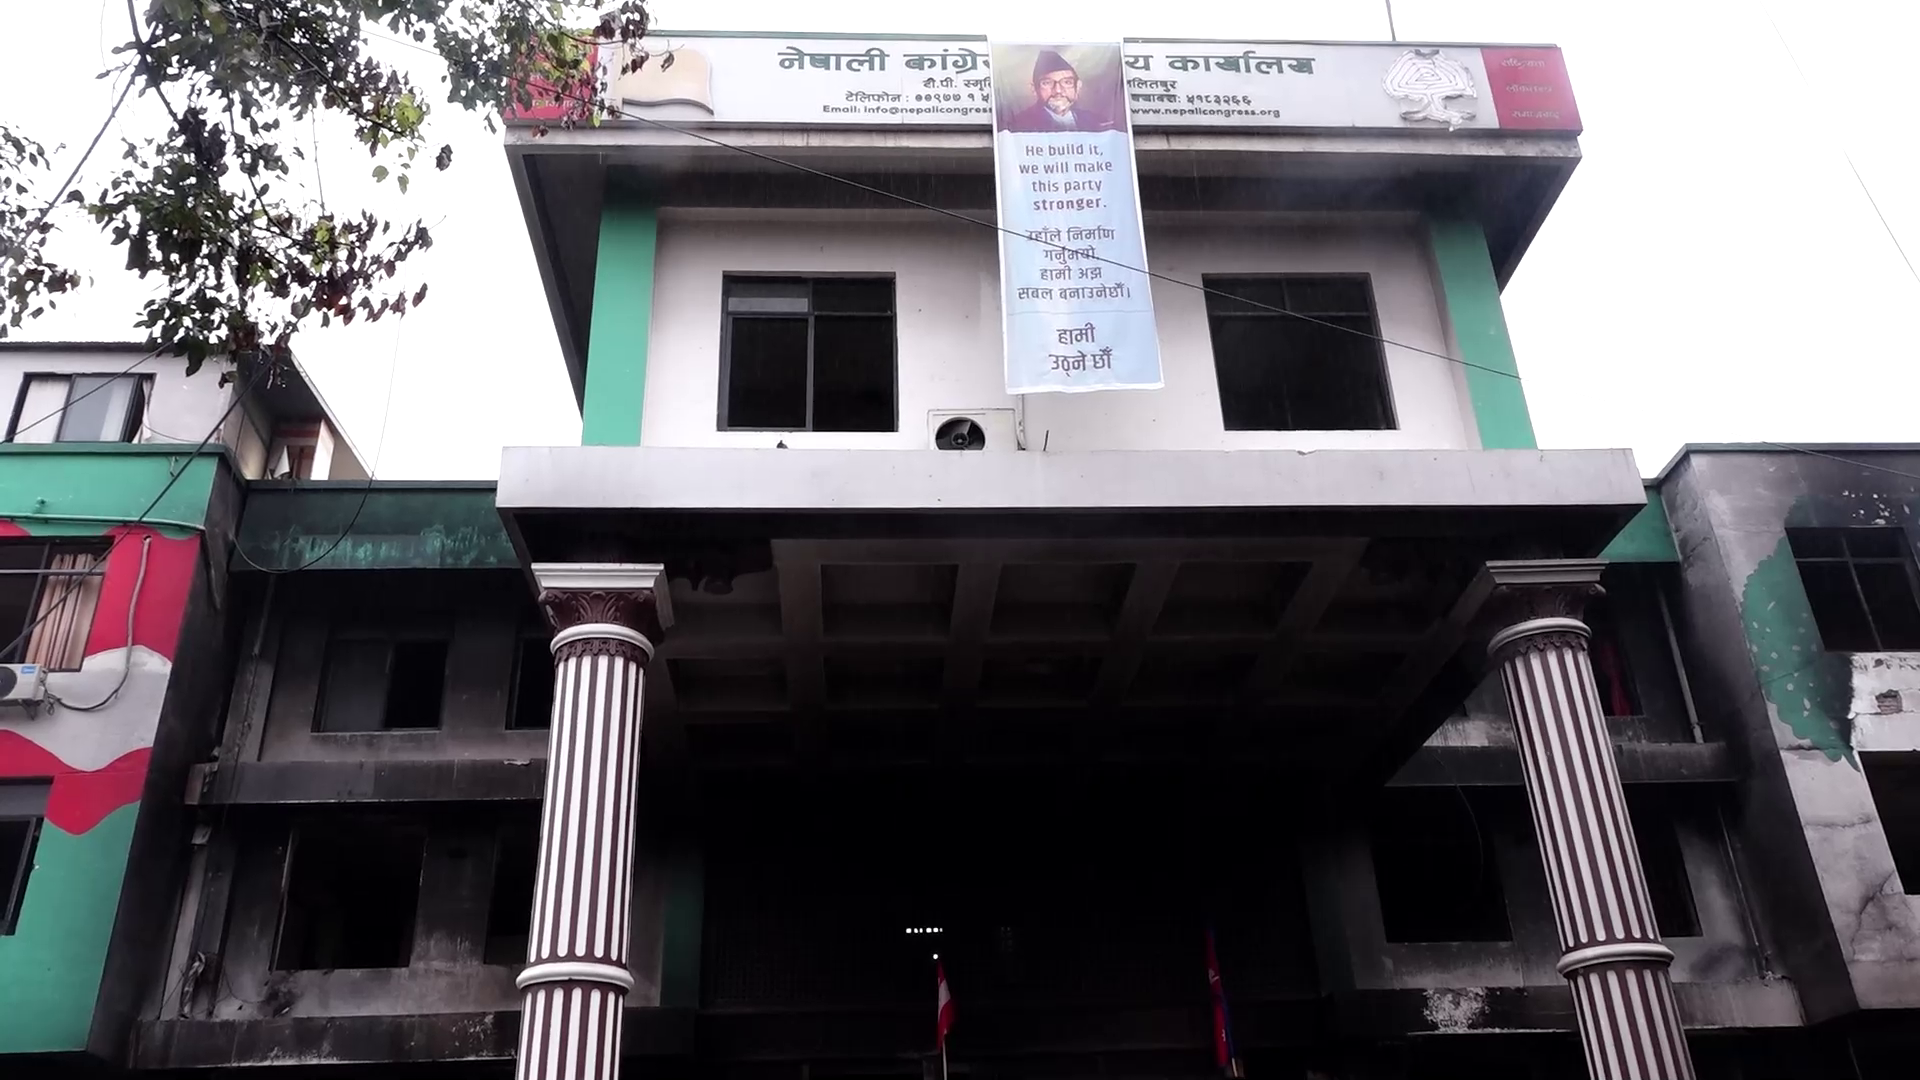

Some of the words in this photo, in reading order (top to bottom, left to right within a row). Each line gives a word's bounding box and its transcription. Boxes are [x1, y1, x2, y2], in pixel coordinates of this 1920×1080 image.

[903, 48, 990, 74] कांग्रे
[823, 105, 860, 113] Email:
[1130, 107, 1280, 118] www.nepalicongress.org
[1026, 145, 1043, 156] He
[1048, 144, 1084, 156] build
[1089, 144, 1104, 156] it,
[1019, 164, 1039, 174] we
[1044, 162, 1069, 174] will
[1074, 161, 1112, 173] make
[1032, 180, 1059, 192] this
[1064, 180, 1102, 194] party
[1033, 198, 1107, 211] stronger.
[1066, 225, 1115, 241] निर्माण
[1040, 265, 1072, 280] हामी
[1078, 267, 1102, 280] अझ
[1017, 287, 1053, 300] सबल
[1056, 322, 1096, 345] हामी
